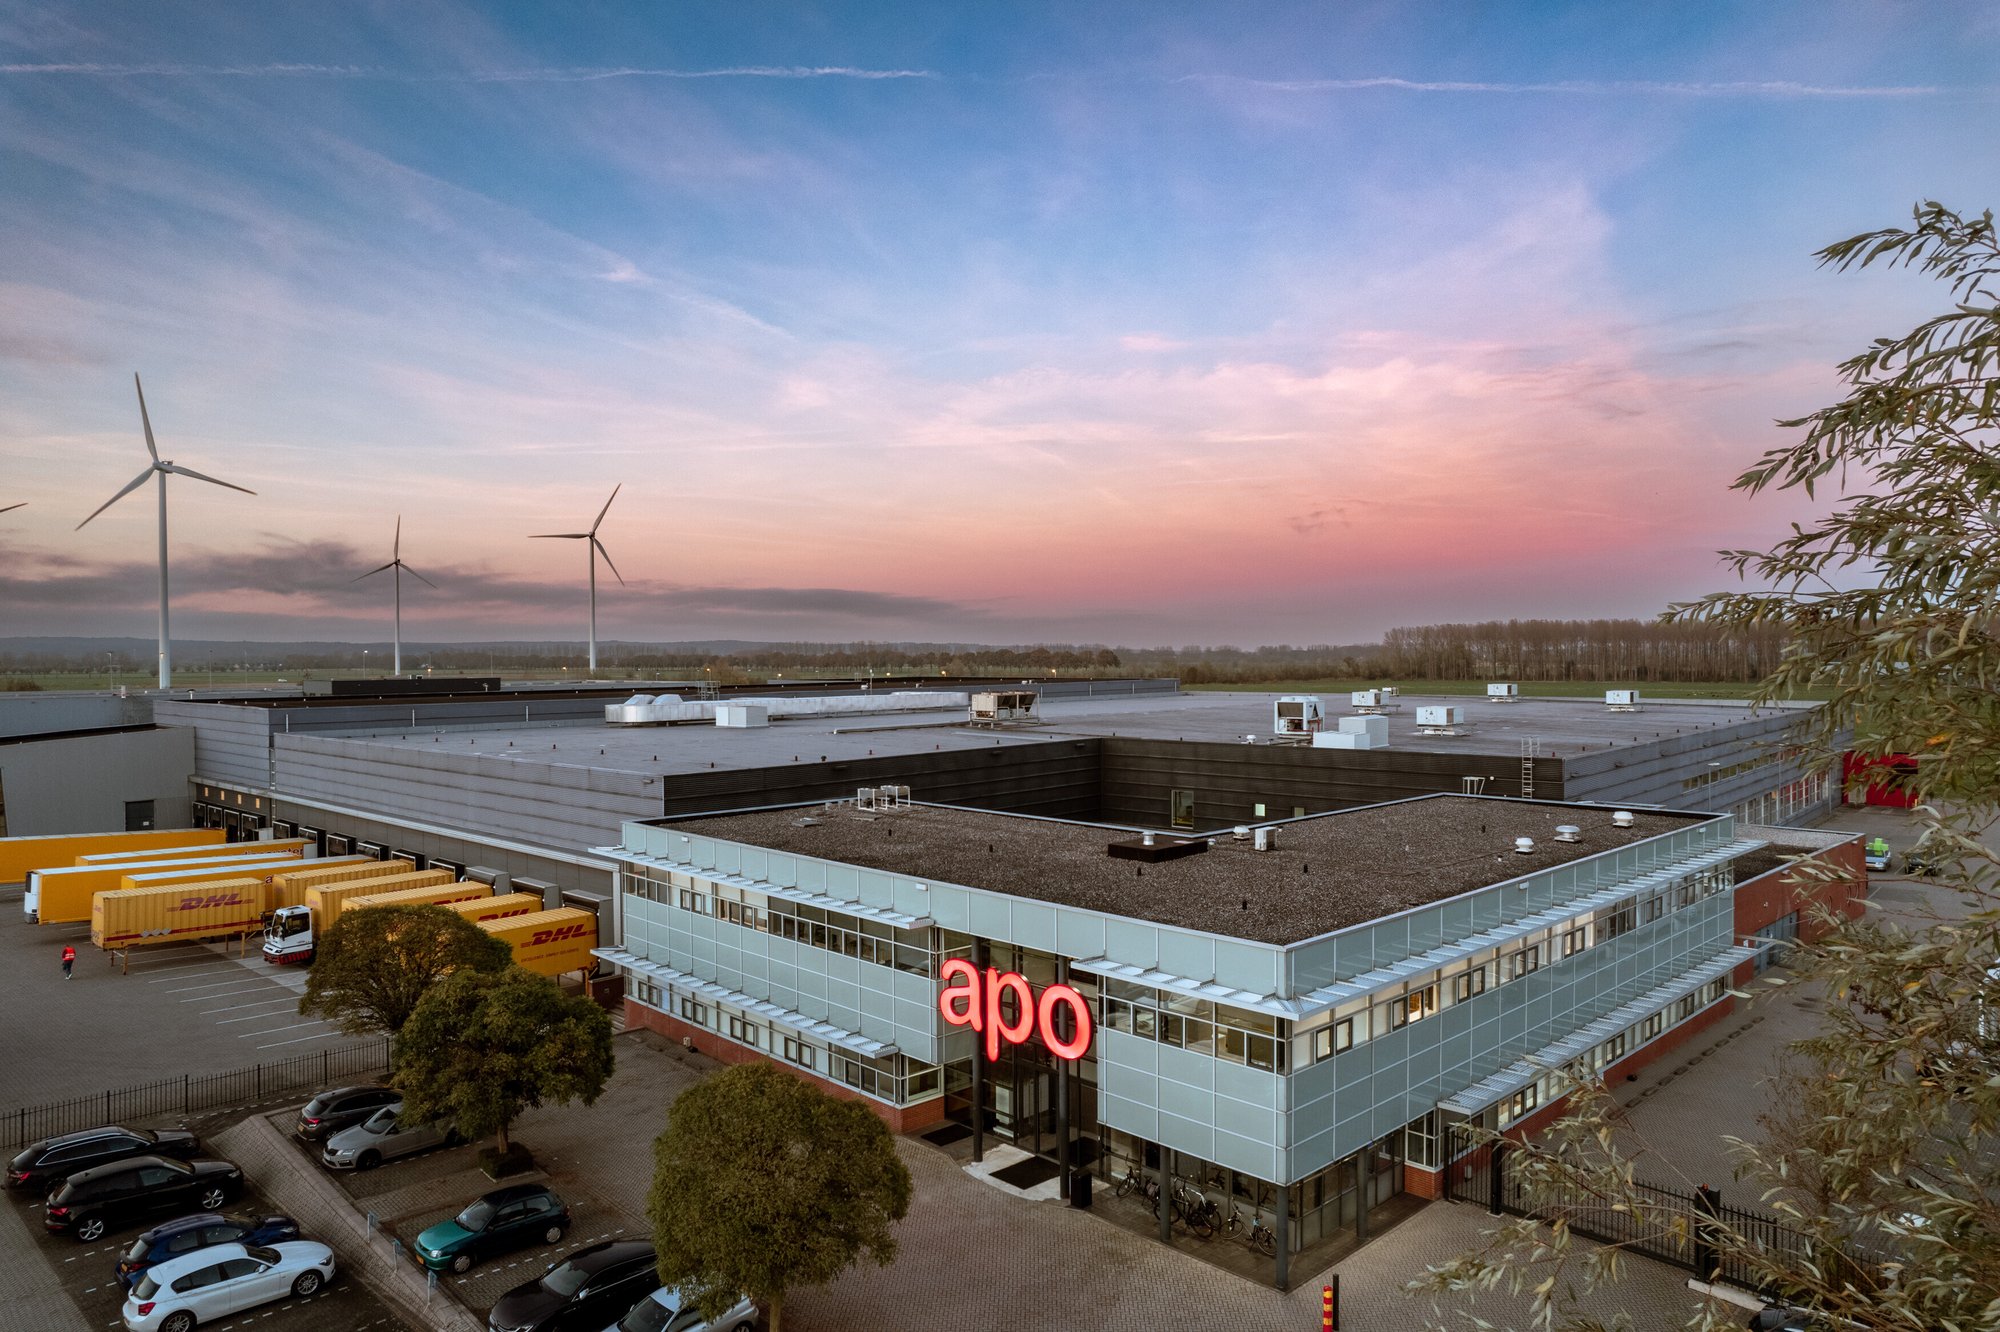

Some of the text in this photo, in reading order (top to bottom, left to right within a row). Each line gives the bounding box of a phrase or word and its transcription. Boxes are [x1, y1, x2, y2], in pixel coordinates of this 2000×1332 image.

[179, 893, 242, 911] DHL
[531, 924, 588, 946] DHL
[940, 957, 1094, 1062] apo
